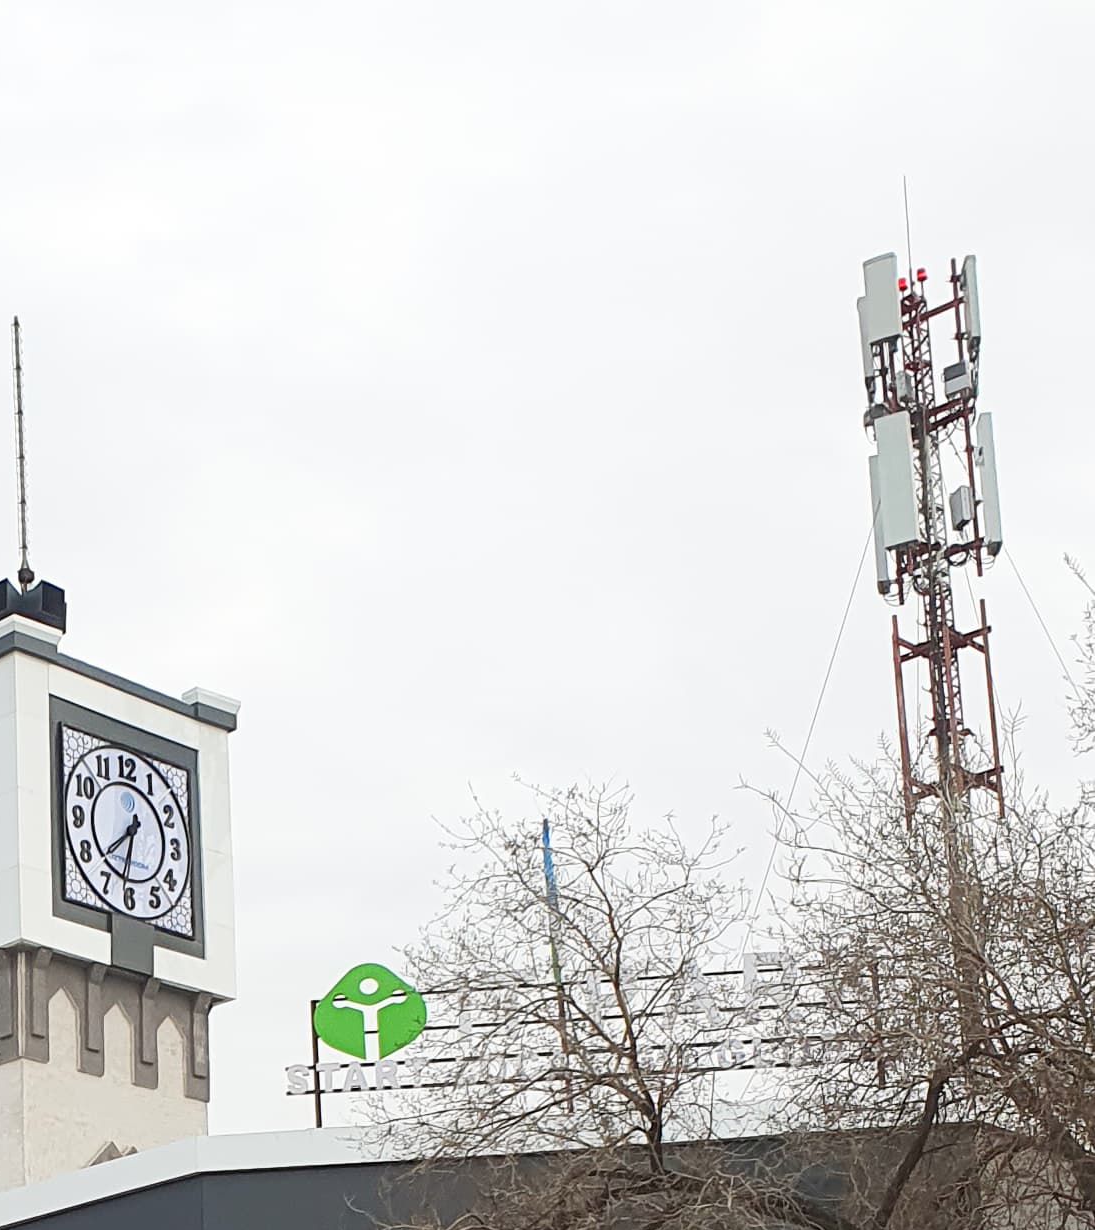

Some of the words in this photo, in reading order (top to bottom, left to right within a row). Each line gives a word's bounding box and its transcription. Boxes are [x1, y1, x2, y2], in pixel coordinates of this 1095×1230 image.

[95, 754, 110, 781] 11
[118, 755, 137, 783] 12
[76, 773, 95, 800] 10
[146, 773, 154, 796] 1
[72, 805, 85, 828] 9
[163, 804, 175, 829] 2
[79, 840, 92, 863] 8
[169, 838, 182, 861] 3
[100, 870, 112, 895] 7
[163, 868, 178, 892] 4
[123, 887, 136, 911] 6
[148, 886, 161, 909] 5
